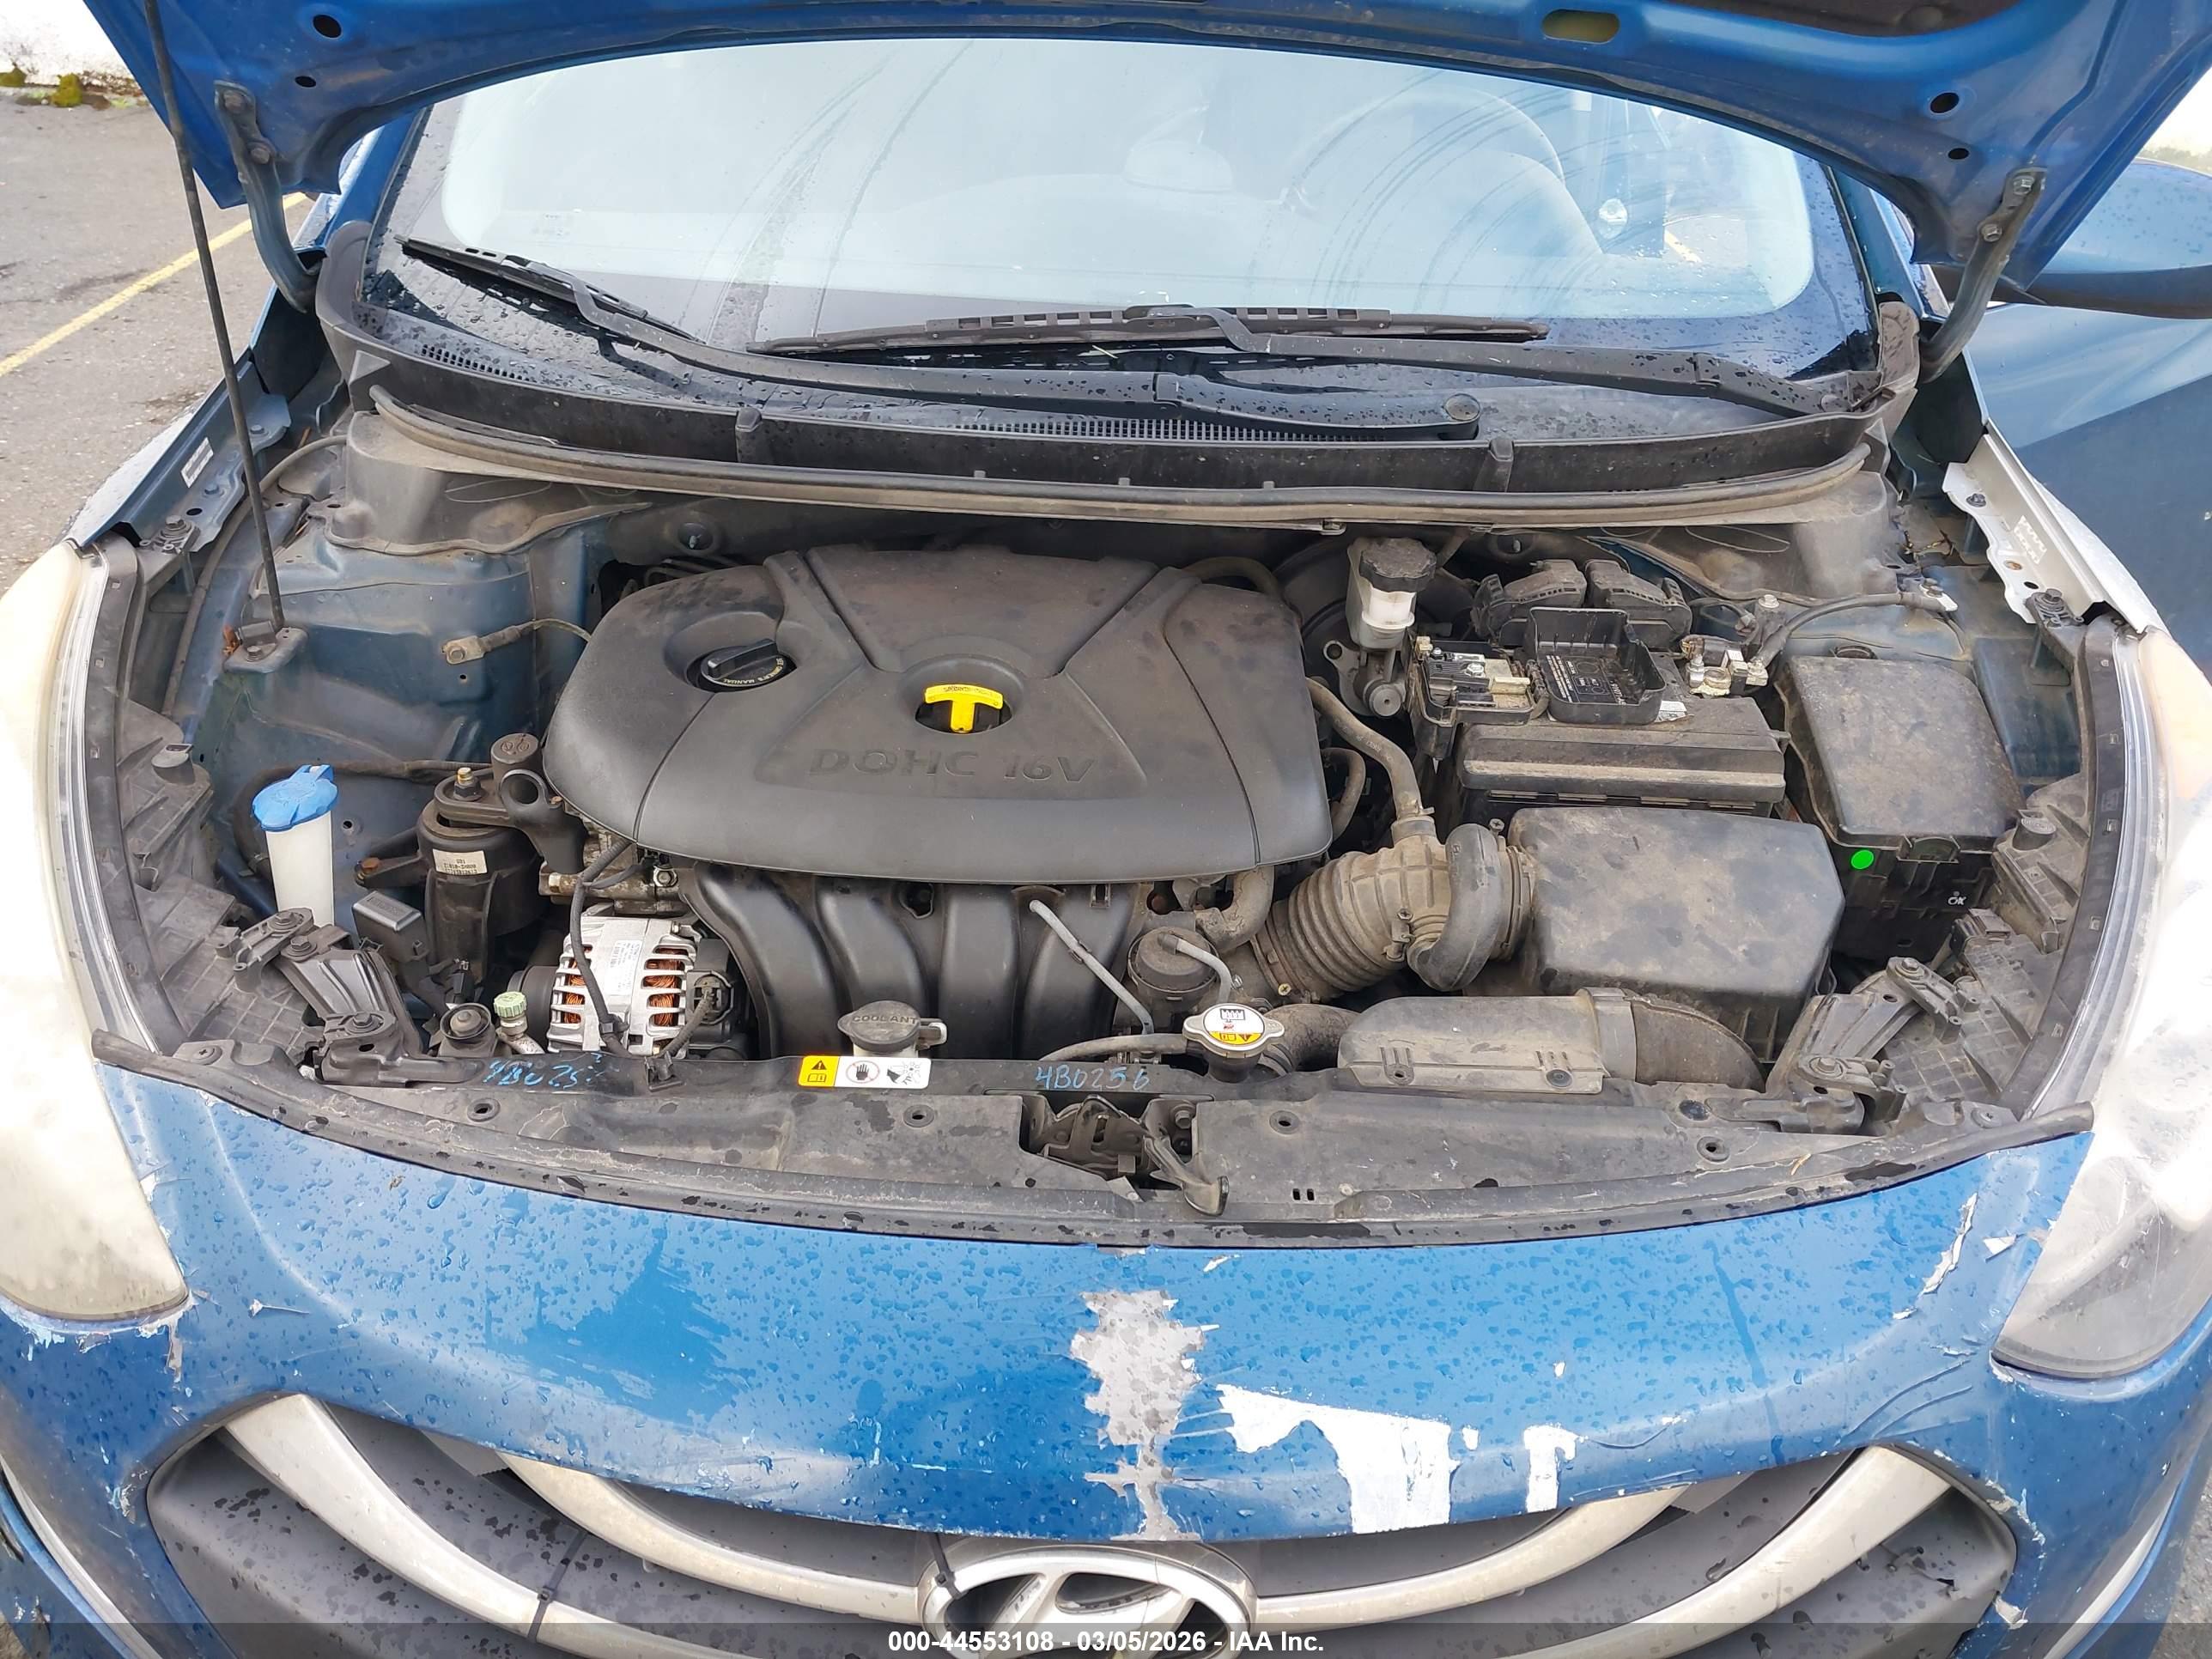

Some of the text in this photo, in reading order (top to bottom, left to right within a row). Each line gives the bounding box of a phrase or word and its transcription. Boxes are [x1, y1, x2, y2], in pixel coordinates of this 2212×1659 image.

[809, 748, 1096, 784] DOHC 16V
[853, 1015, 917, 1025] COOLANT
